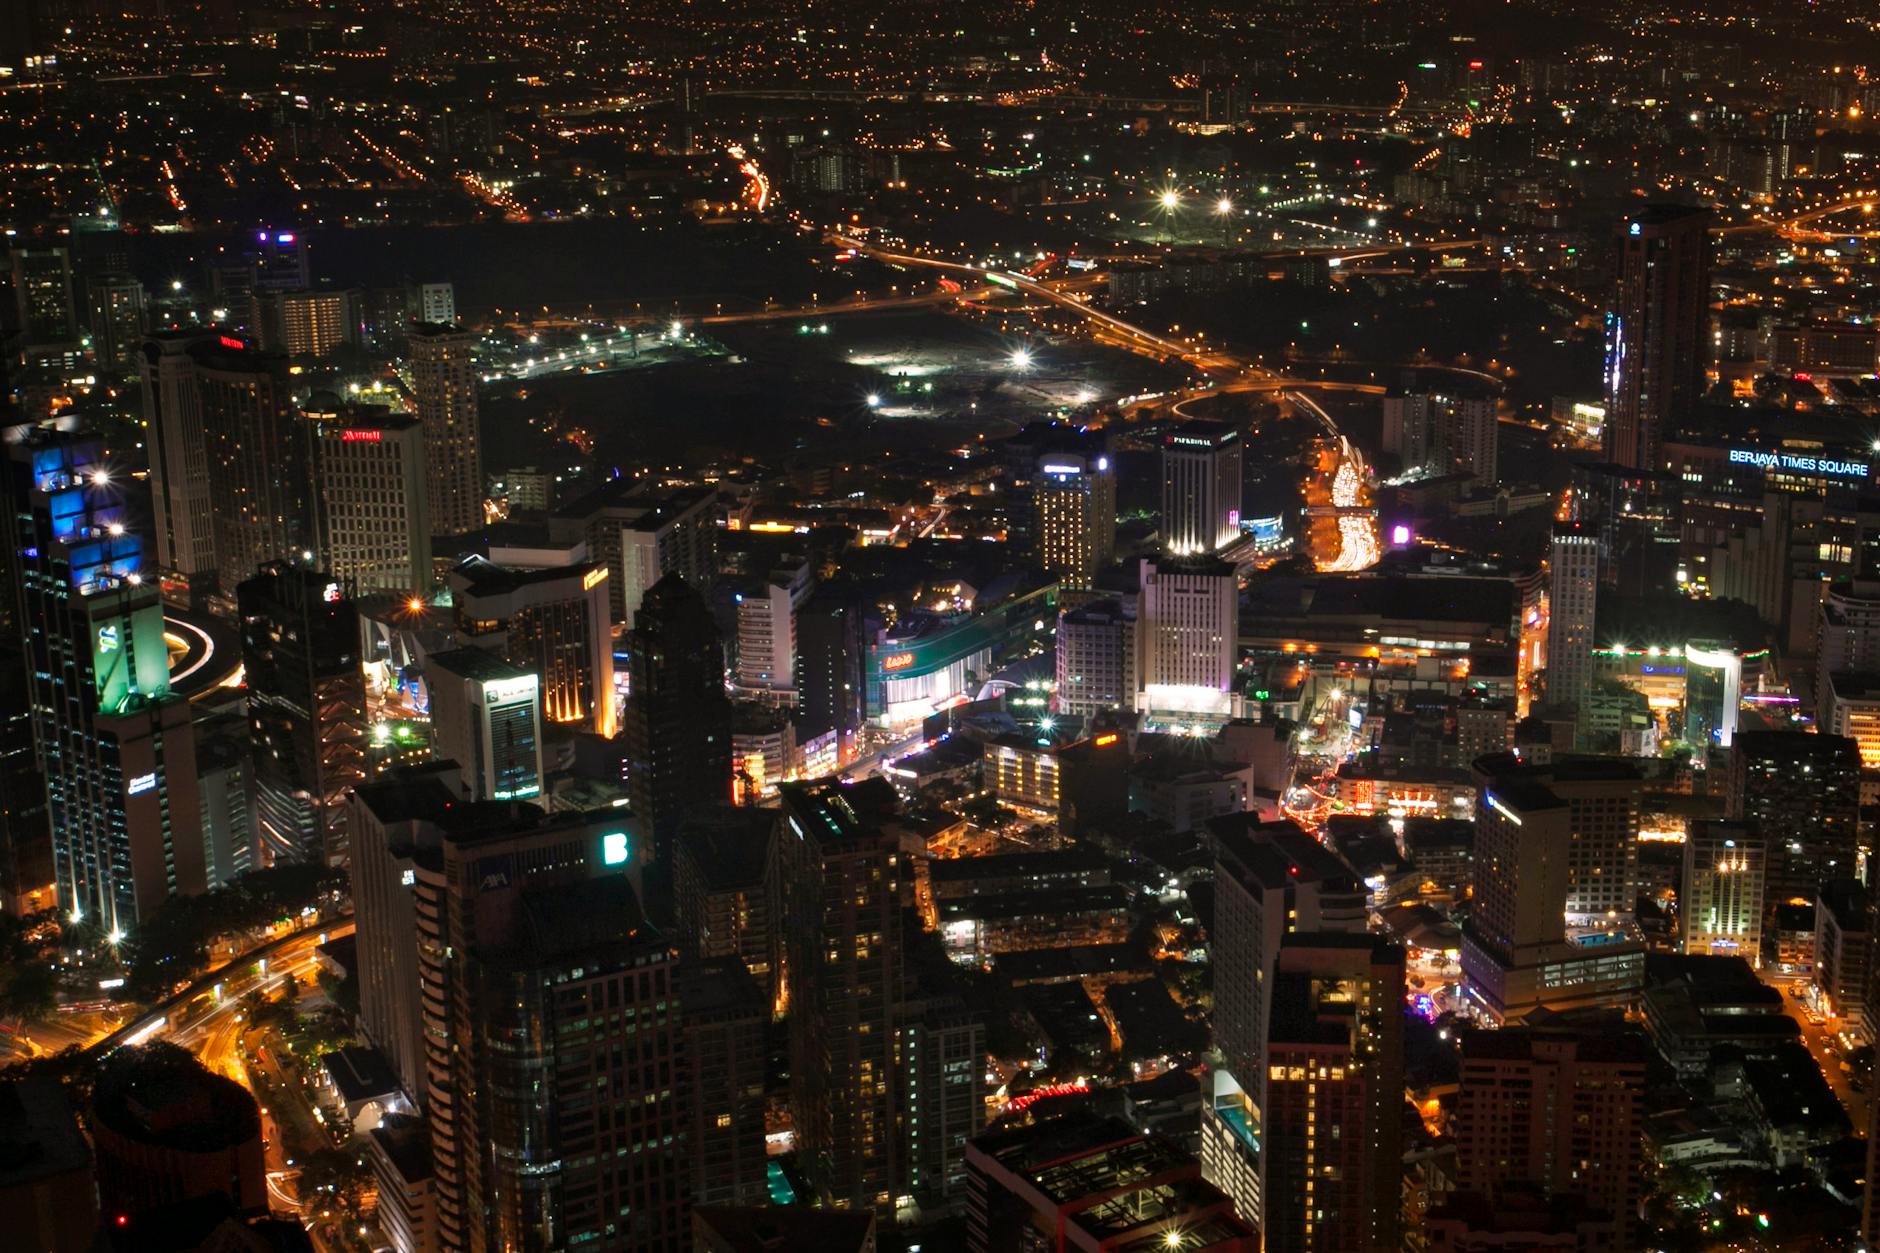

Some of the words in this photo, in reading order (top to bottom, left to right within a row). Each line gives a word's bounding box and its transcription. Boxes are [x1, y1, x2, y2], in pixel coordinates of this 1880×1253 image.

[1730, 450, 1779, 466] BERJAYA
[1781, 456, 1815, 470] TIMES
[1818, 460, 1868, 476] SQUARE
